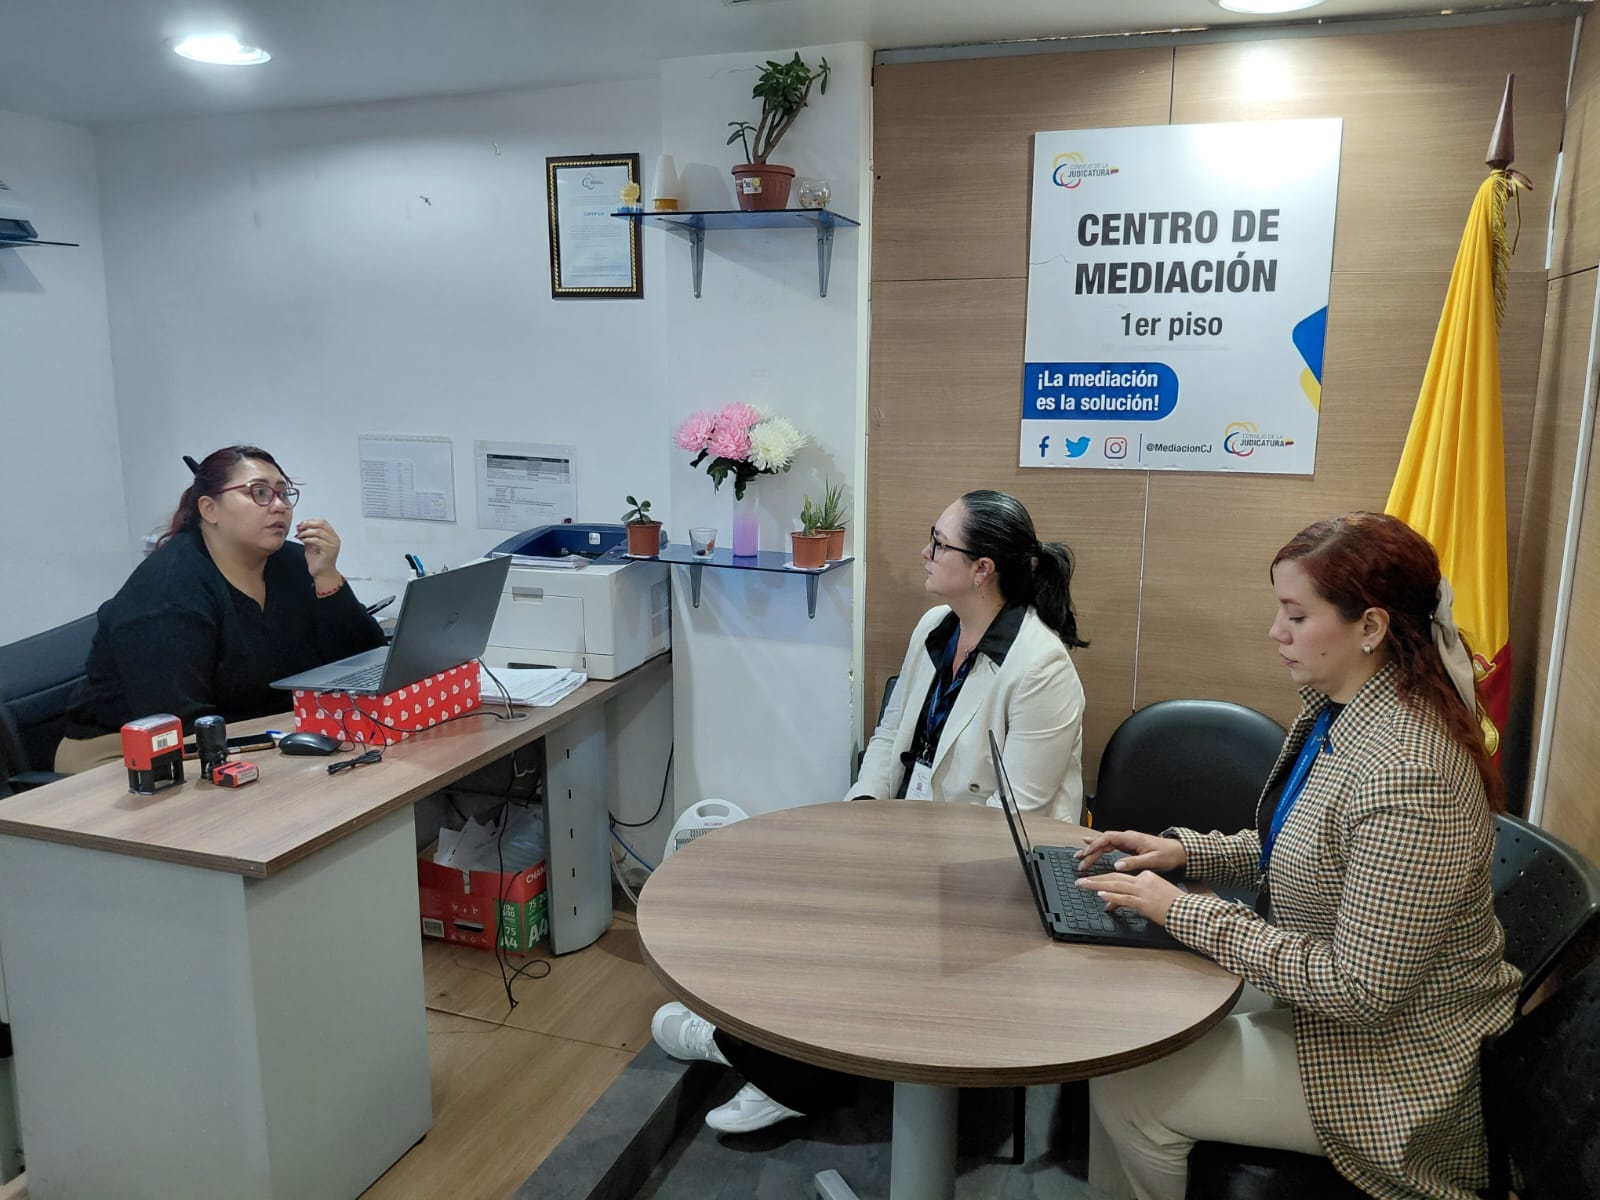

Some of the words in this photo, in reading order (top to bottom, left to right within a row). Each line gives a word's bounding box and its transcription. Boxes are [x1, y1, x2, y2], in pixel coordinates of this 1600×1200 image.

[1067, 168, 1110, 178] JUDICATURA
[1077, 210, 1218, 247] CENTRO
[1231, 208, 1280, 243] DE
[1075, 251, 1278, 295] MEDIACIÓN
[1120, 312, 1161, 336] 1er
[1168, 311, 1223, 341] piso
[1037, 370, 1063, 390] ¡La
[1068, 369, 1158, 387] mediación
[1036, 396, 1056, 410] es
[1060, 393, 1075, 410] la
[1080, 394, 1159, 411] solución!
[1146, 442, 1213, 453] @MediacionCJ
[1240, 439, 1284, 447] JUDICATURA
[505, 926, 517, 936] 75
[528, 918, 549, 949] A4
[500, 935, 518, 949] A4
